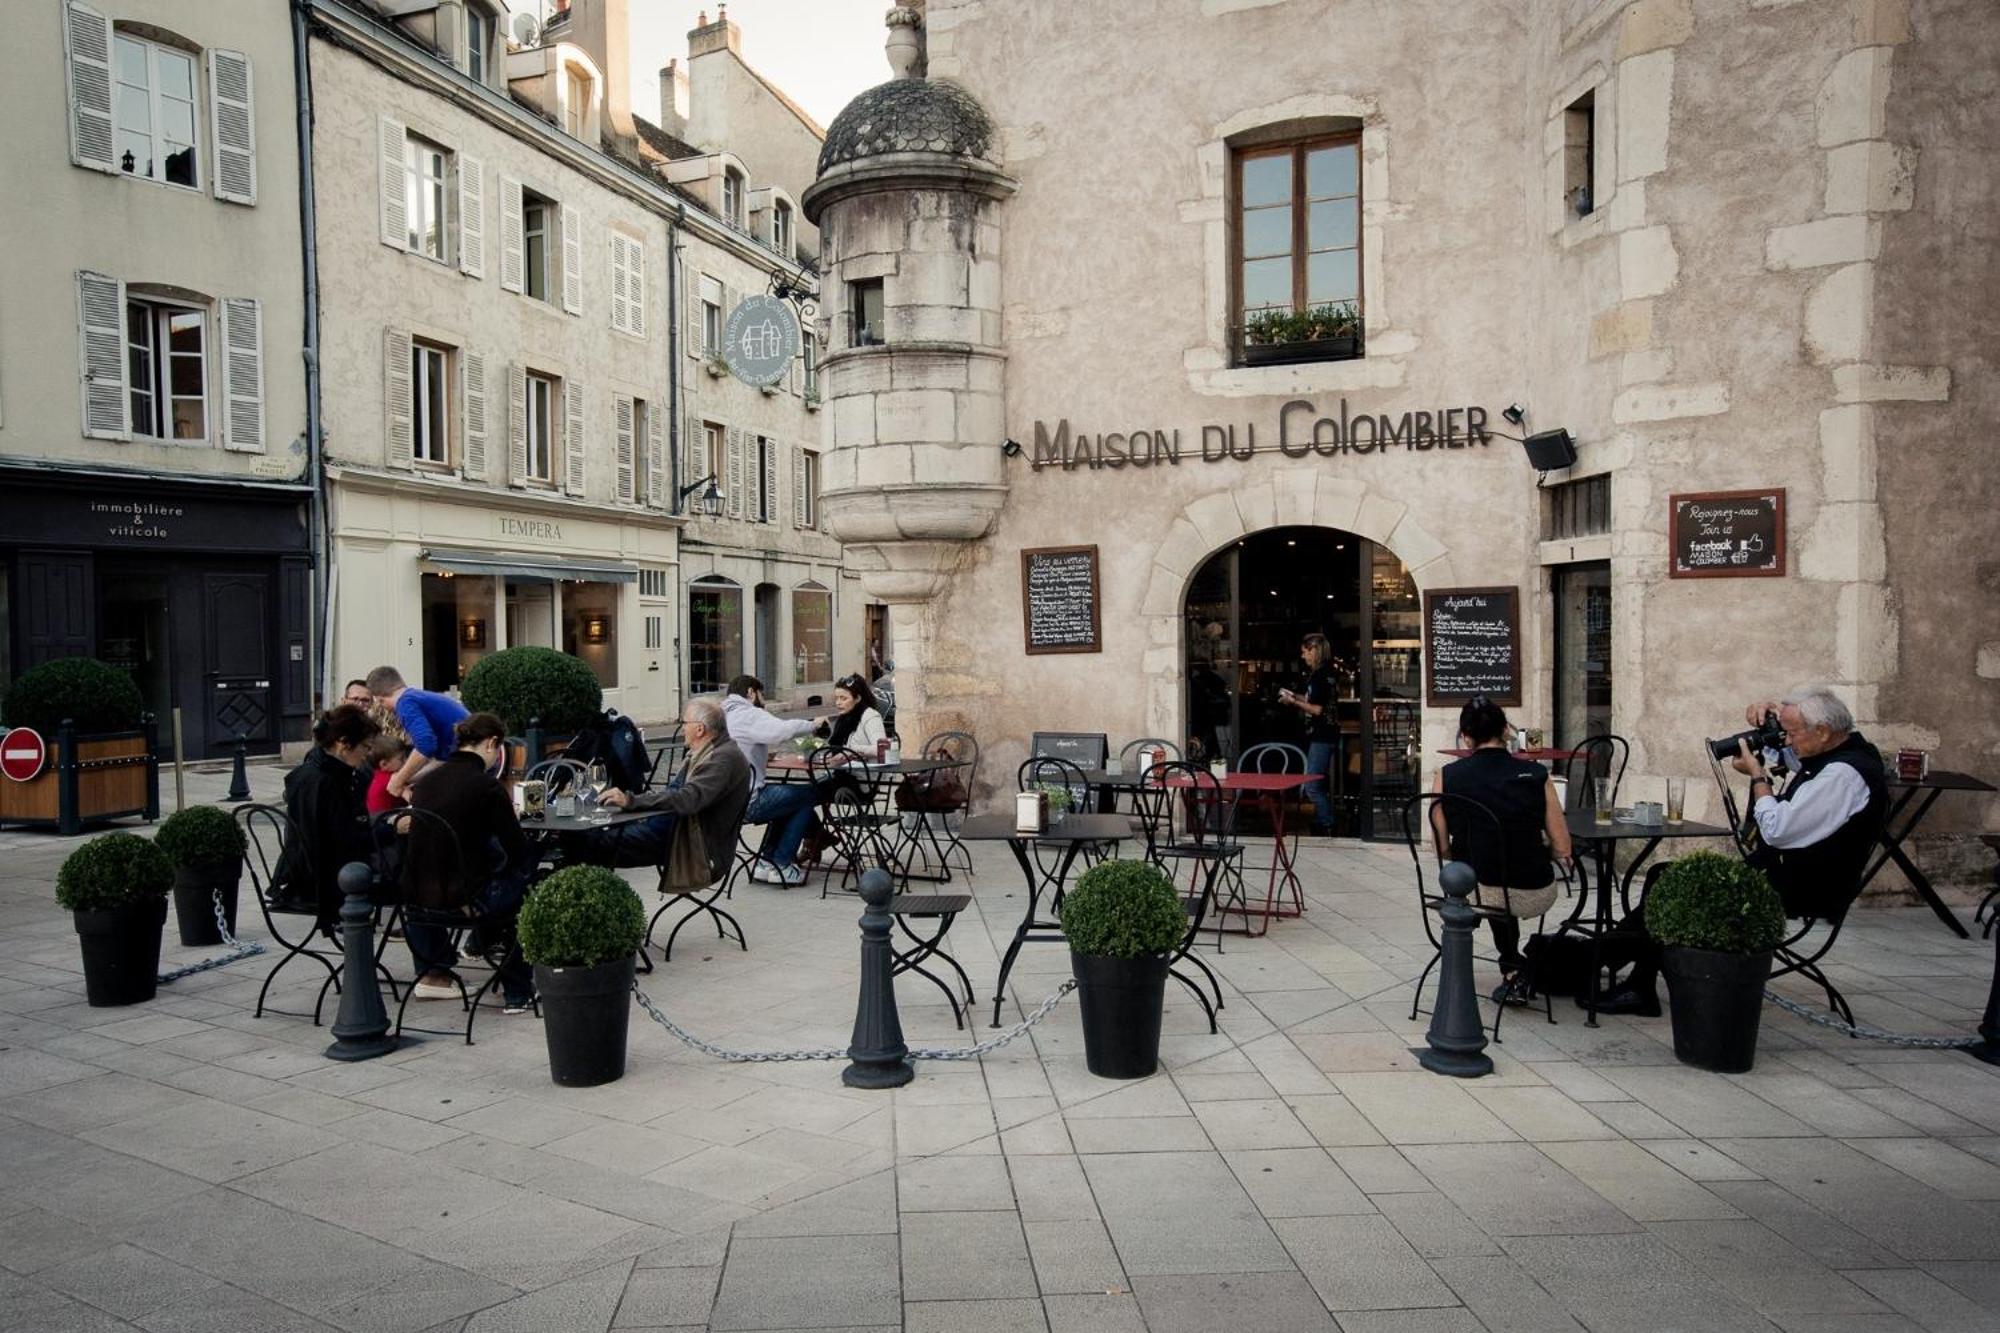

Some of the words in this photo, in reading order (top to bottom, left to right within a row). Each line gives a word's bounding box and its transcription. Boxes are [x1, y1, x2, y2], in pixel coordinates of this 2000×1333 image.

[134, 514, 143, 525] &
[109, 526, 168, 538] viticole
[499, 518, 561, 539] TEMPERA
[1689, 539, 1733, 552] facebook
